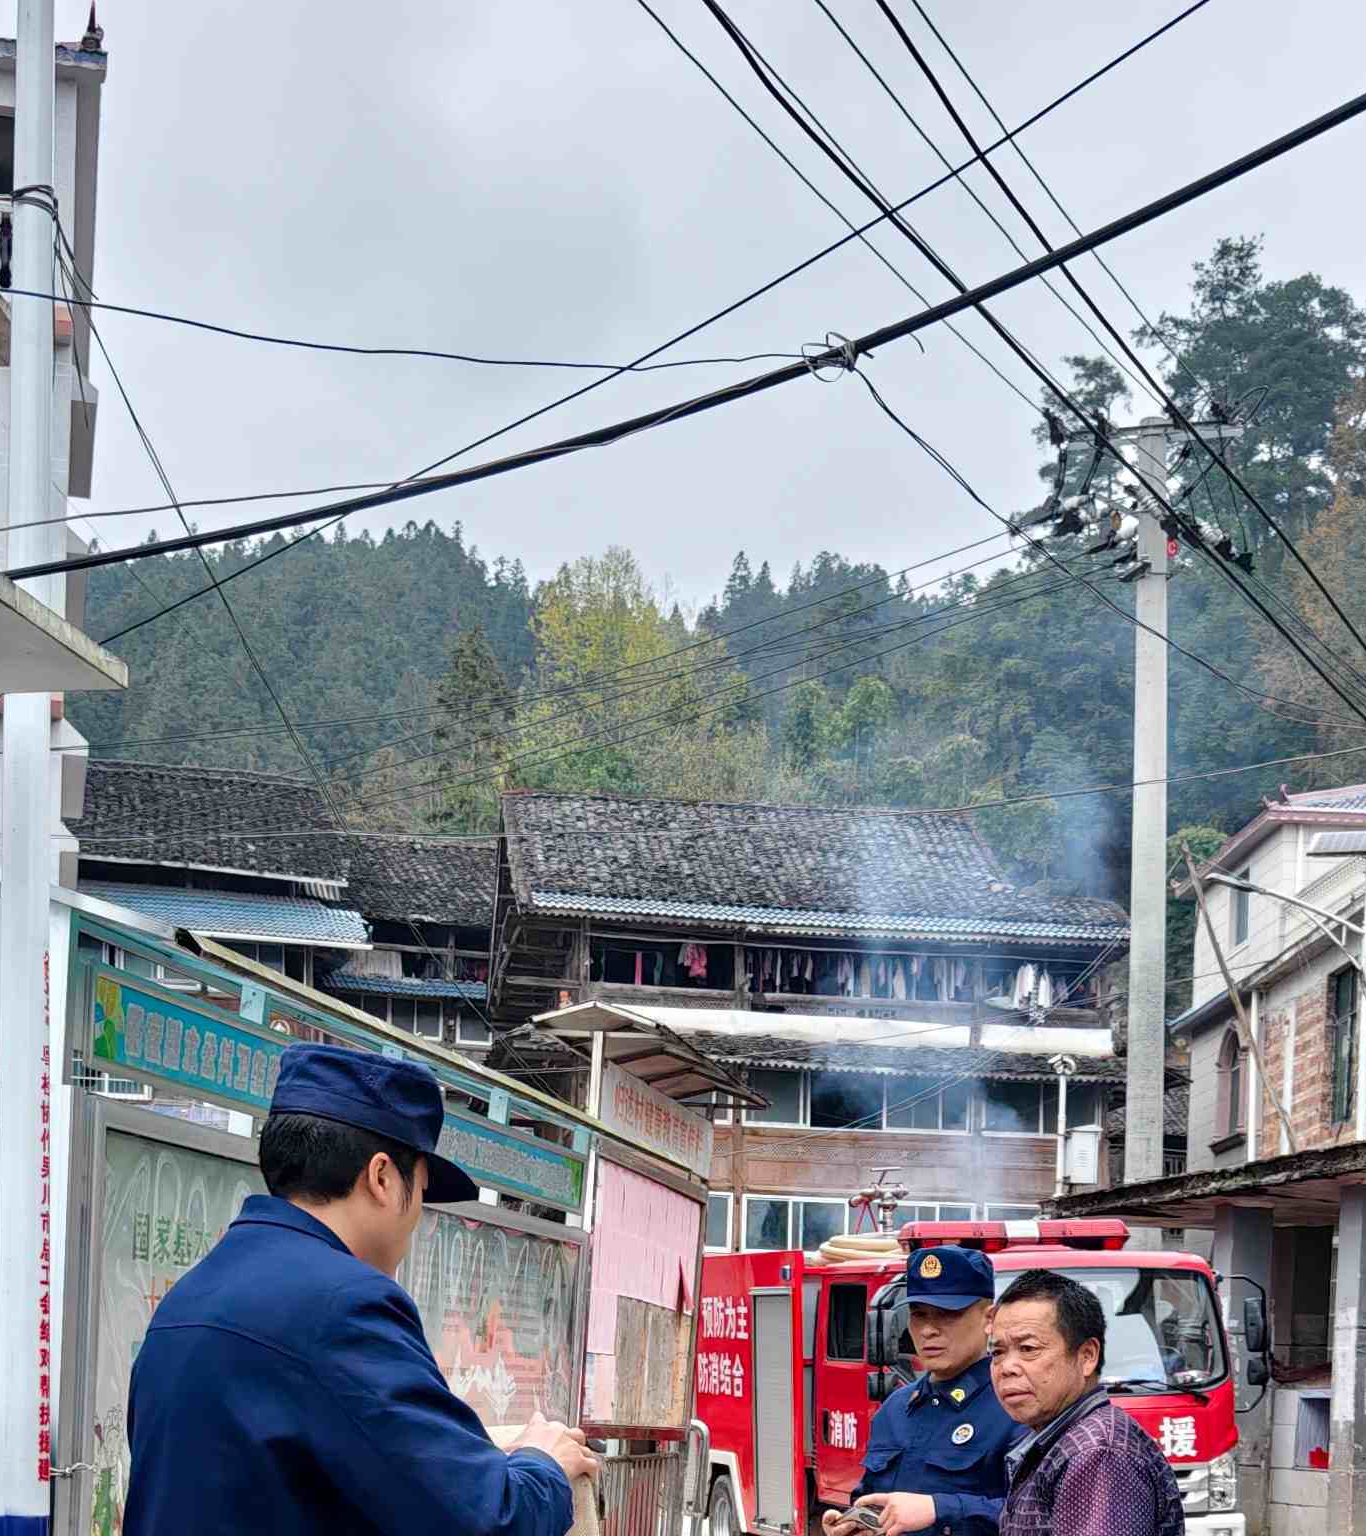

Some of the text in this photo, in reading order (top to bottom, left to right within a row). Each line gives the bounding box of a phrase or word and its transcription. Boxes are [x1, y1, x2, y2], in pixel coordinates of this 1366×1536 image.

[701, 1295, 749, 1341] 预防为主
[697, 1352, 745, 1398] 防消结合
[829, 1410, 858, 1450] 消防
